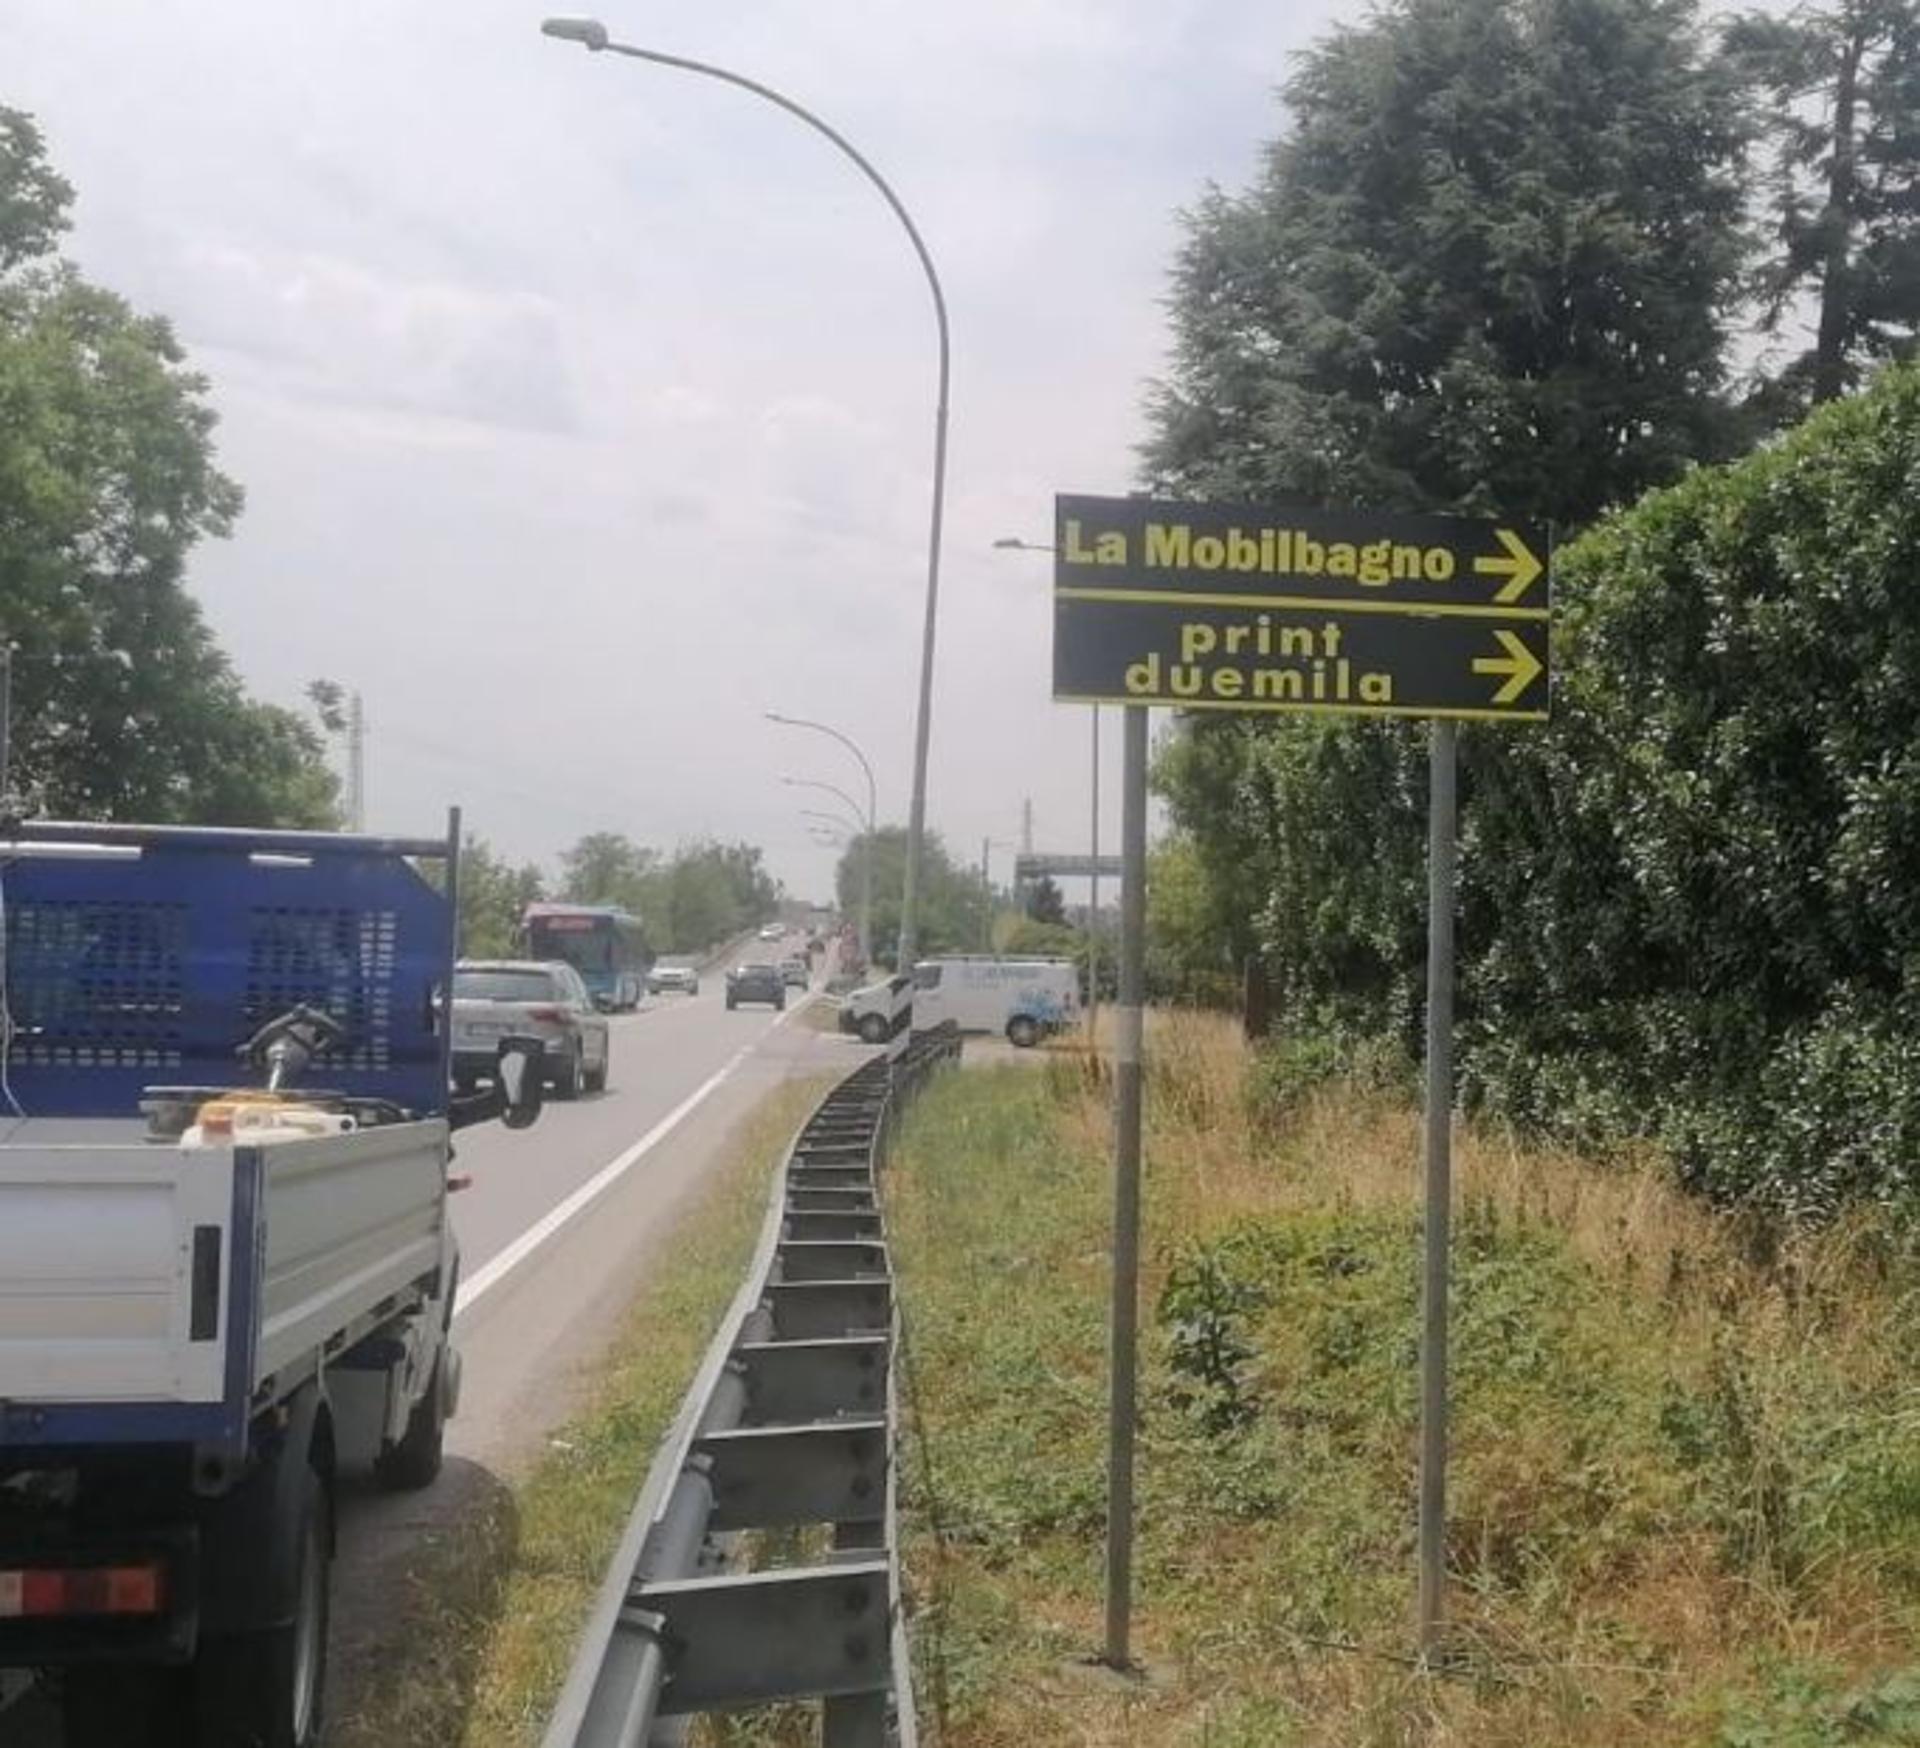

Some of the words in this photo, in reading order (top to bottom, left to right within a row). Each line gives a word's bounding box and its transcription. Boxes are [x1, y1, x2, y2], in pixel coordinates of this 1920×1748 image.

[1063, 519, 1127, 566] La
[1145, 523, 1456, 587] Mobilbagno
[1180, 615, 1342, 662] print
[1124, 652, 1393, 703] duemila
